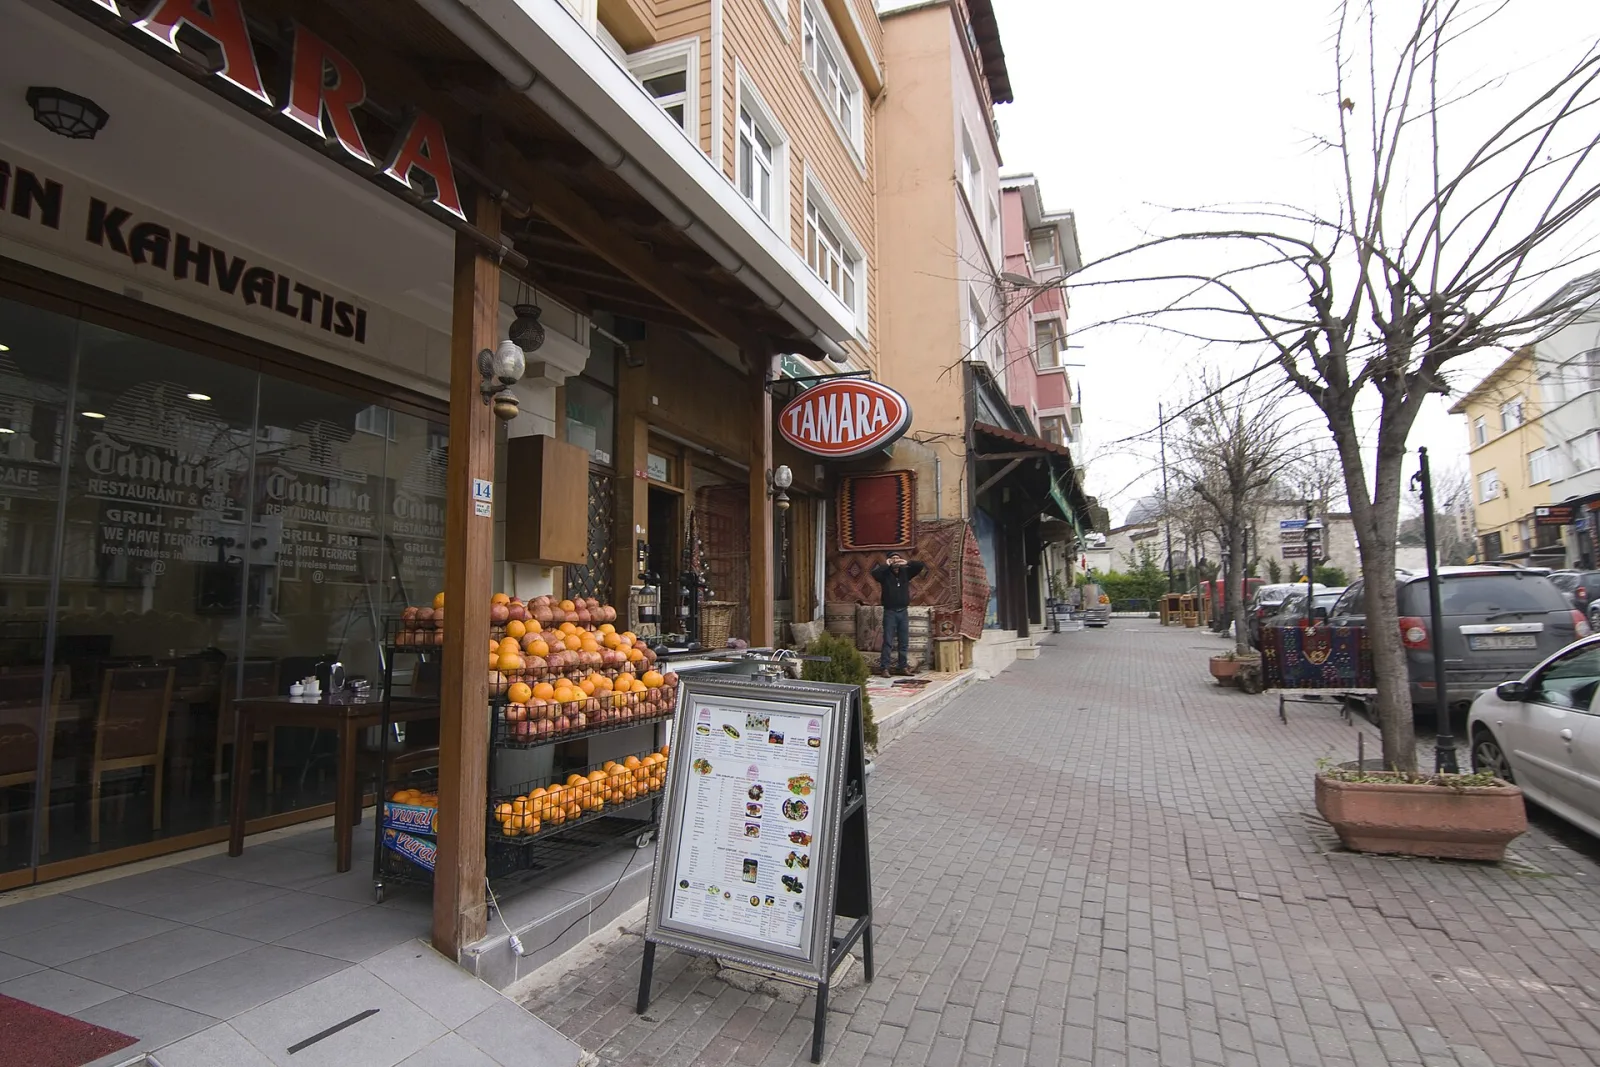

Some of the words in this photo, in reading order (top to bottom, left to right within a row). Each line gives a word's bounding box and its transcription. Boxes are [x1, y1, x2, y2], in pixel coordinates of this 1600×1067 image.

[91, 0, 468, 222] ARA
[85, 196, 368, 345] KAHVALTISI
[789, 392, 890, 444] TAMARA
[85, 431, 233, 493] Tamara
[88, 478, 185, 504] RESTAURANT
[187, 492, 198, 505] &
[201, 494, 235, 511] CAFE
[266, 466, 371, 513] Tamara
[475, 482, 491, 498] 14
[106, 509, 166, 527] GRILL
[173, 516, 214, 531] FISH
[266, 503, 334, 524] RESTAURANT
[347, 515, 372, 529] CAFE
[103, 526, 124, 541] WE
[127, 528, 160, 544] HAVE
[163, 532, 214, 548] TERRACE
[281, 528, 324, 543] GRILL
[328, 534, 358, 547] FISH
[403, 542, 436, 554] GRILL
[102, 543, 124, 556] free
[127, 546, 170, 559] wireless
[278, 543, 293, 556] WE
[296, 545, 319, 558] HAVE
[321, 547, 357, 561] TERRACE
[151, 559, 166, 575] @
[296, 559, 327, 571] wireless
[328, 562, 357, 572] internet
[312, 570, 324, 584] @
[392, 807, 433, 826] vural
[396, 832, 439, 864] vural
